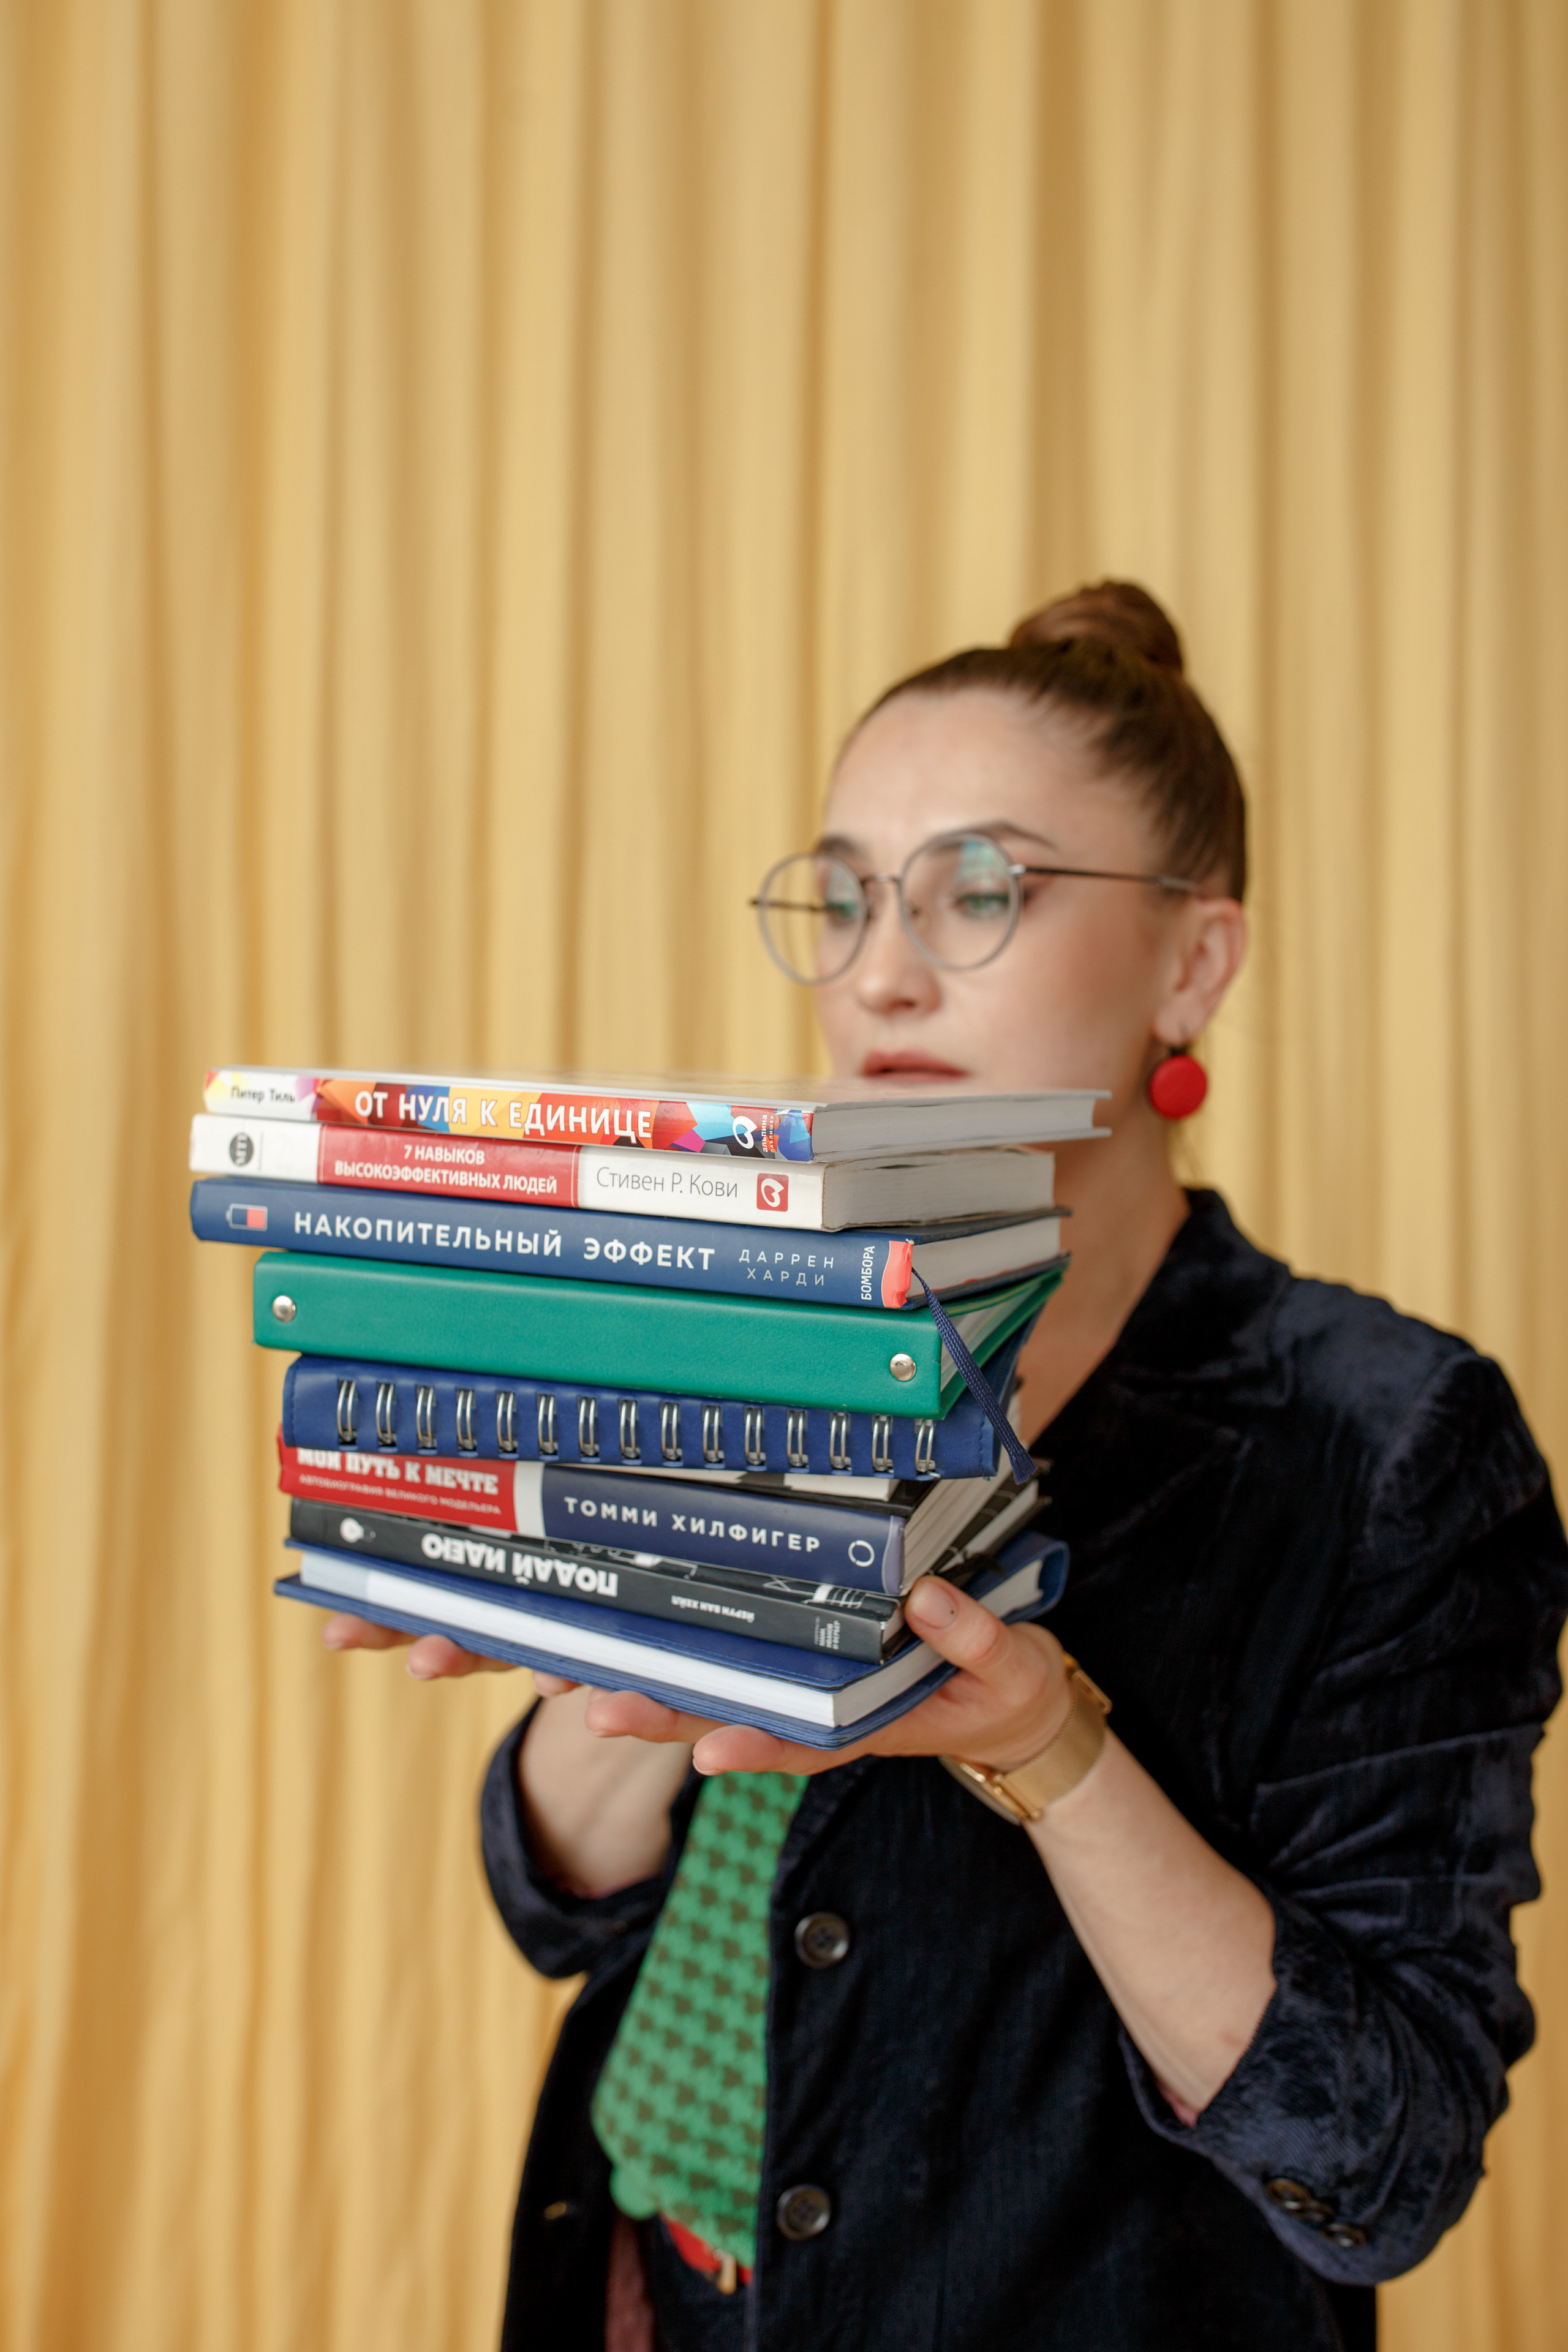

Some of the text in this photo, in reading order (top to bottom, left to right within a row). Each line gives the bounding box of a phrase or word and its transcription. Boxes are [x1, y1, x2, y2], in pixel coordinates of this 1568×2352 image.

[231, 1086, 295, 1102] Питер Тиль
[355, 1090, 652, 1144] ОТ НУЛЯ К ЕДИНИЦЕ
[404, 1145, 485, 1165] 7 НАВЫКОВ
[334, 1160, 557, 1195] ВЫСОКОЭФФЕКТИВНЫХ ЛЮДЕЙ
[597, 1167, 737, 1197] Стивен Р. Кови
[294, 1212, 715, 1270] НАКОПИТЕЛЬНЫЙ ЭФФЕКТ
[739, 1249, 834, 1268] ДАРРЕН
[747, 1268, 824, 1286] ХАРДИ
[861, 1246, 875, 1300] БОМБОРА
[298, 1474, 502, 1515] АВТОБИОГРАФИЯ ВЕЛИКОГО МОДЕЛЬЕРА
[345, 1452, 401, 1480] ПУТЬ
[405, 1460, 421, 1483] К
[424, 1464, 499, 1496] МЕЧТЕ
[564, 1496, 821, 1553] ТОММИ ХИЛФИГЕР
[421, 1533, 619, 1597] ПОДАЙ ИДЕЮ
